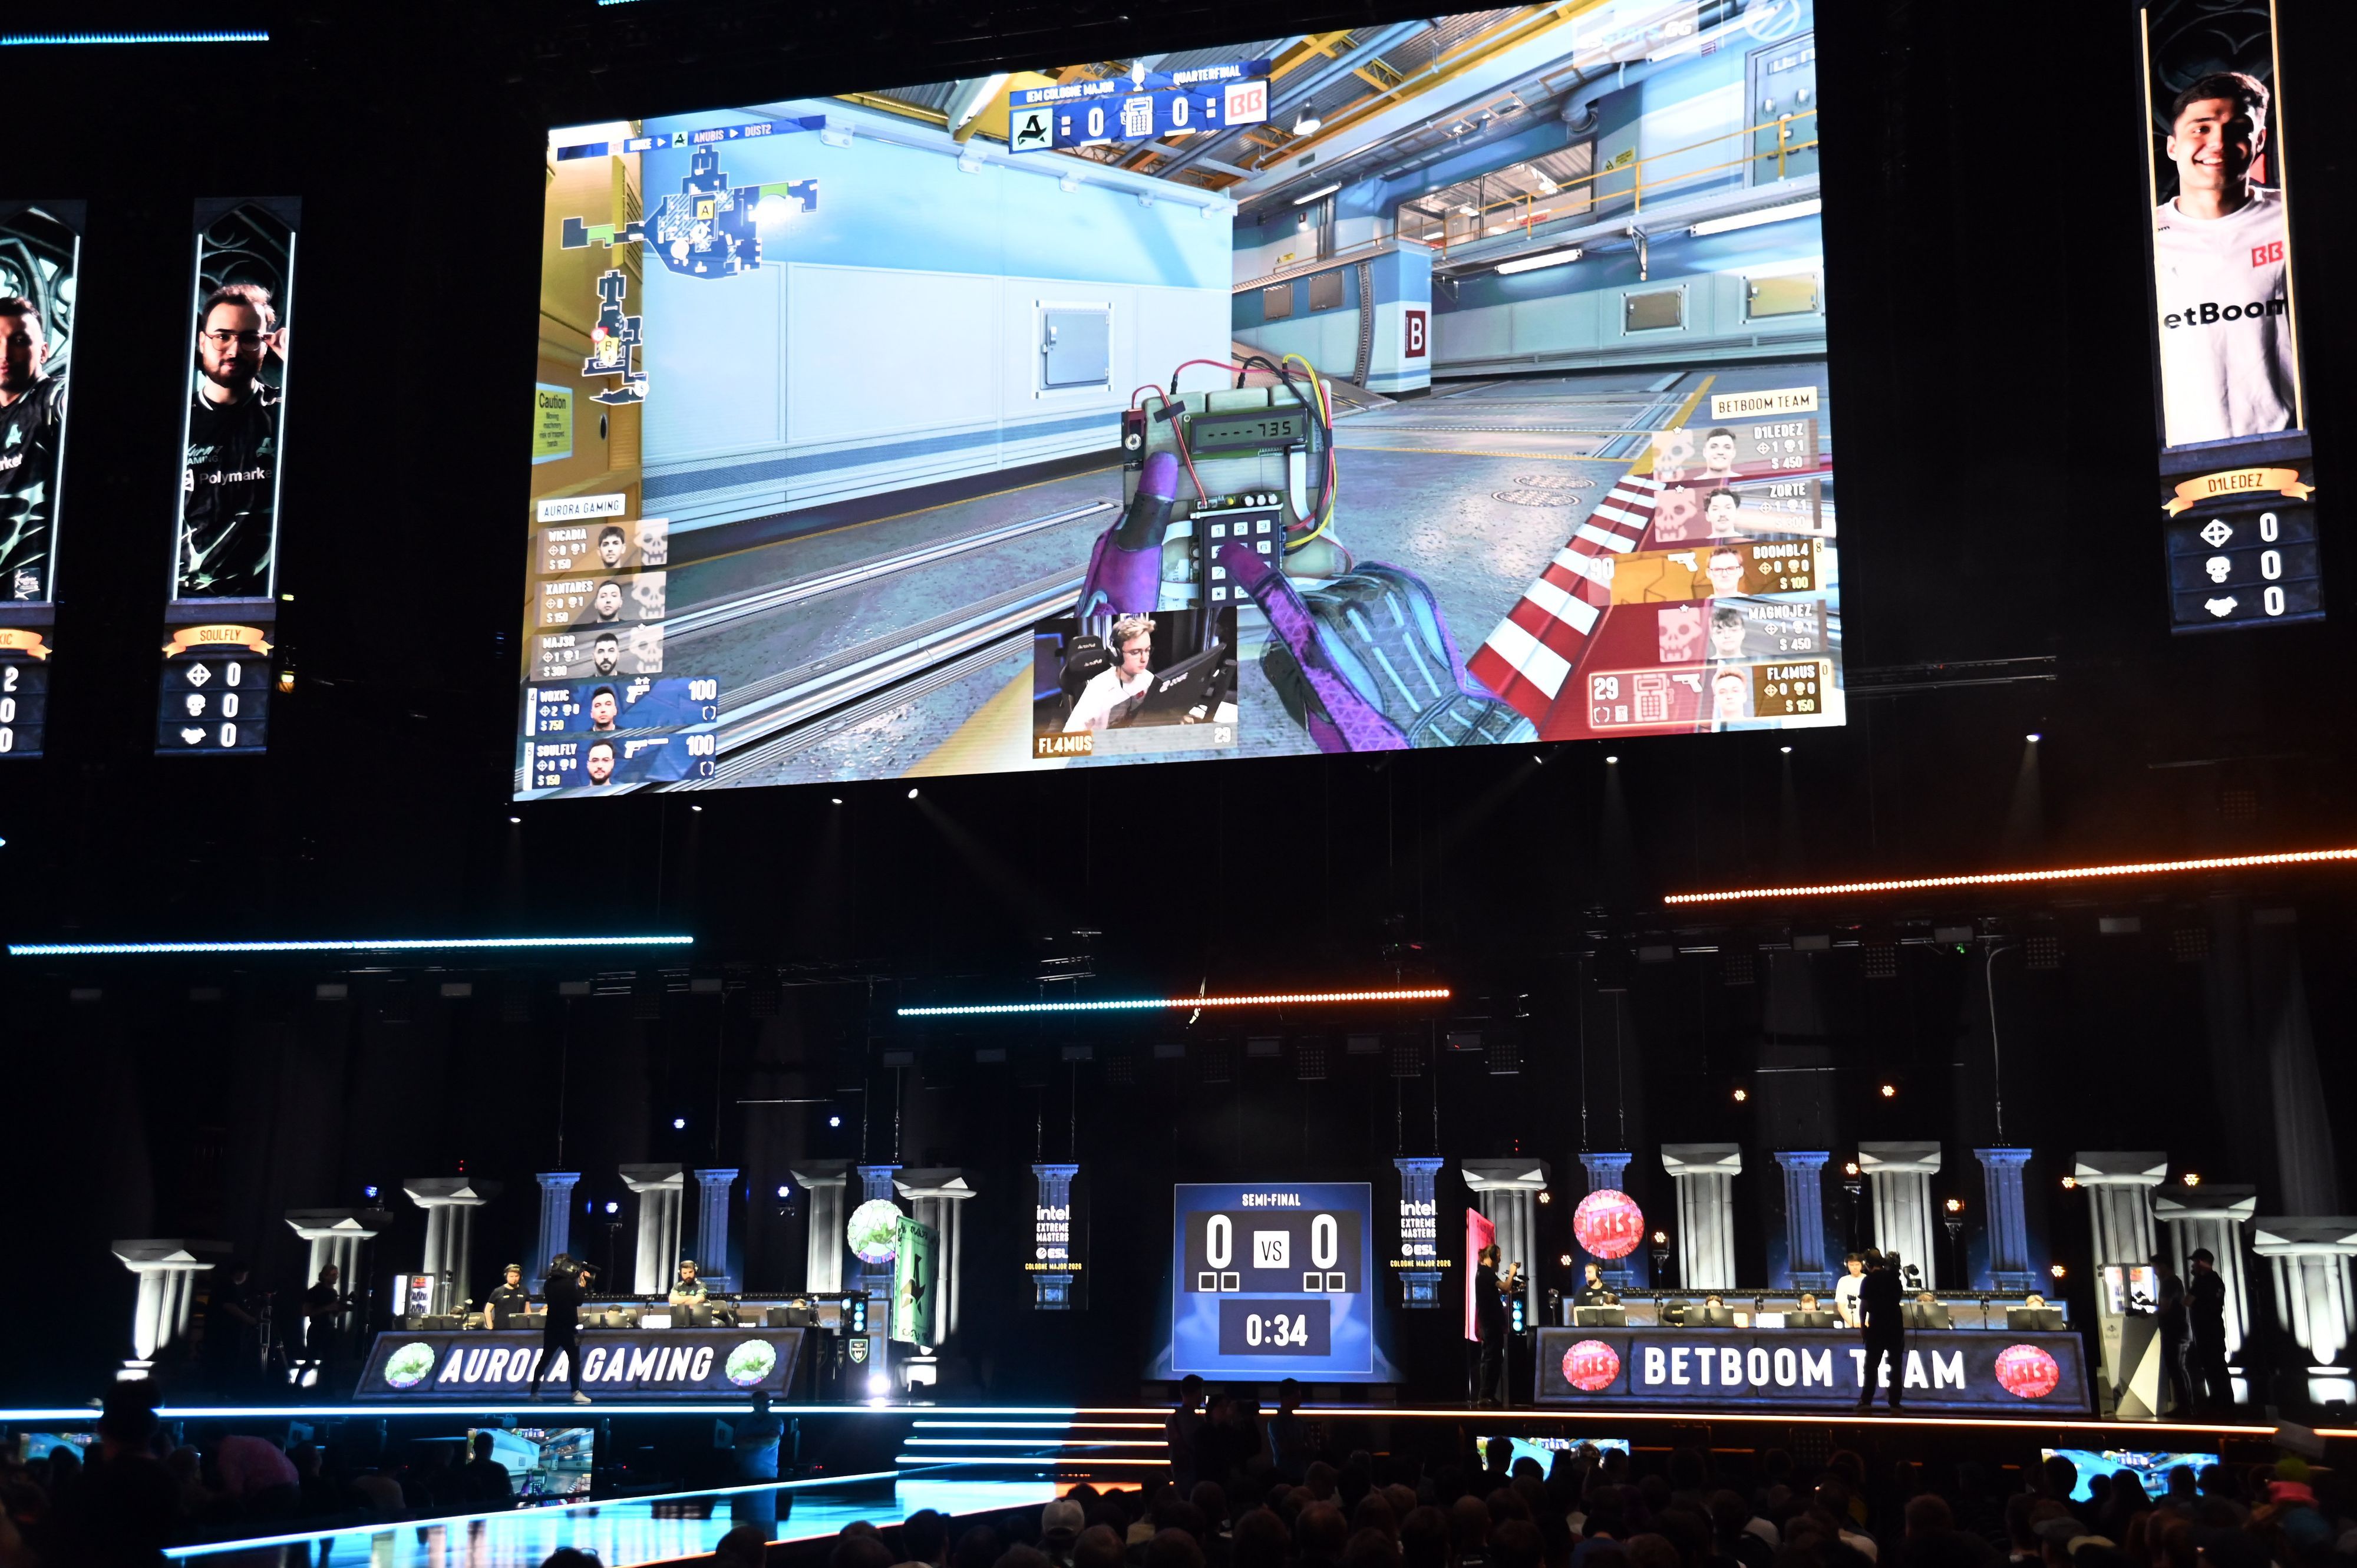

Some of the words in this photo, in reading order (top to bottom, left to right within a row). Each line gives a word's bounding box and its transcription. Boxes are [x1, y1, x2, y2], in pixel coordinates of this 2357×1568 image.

[1173, 65, 1241, 86] QUARTERFINAL
[1026, 90, 1042, 104] IEM
[1043, 85, 1082, 101] COLOGNE
[1083, 81, 1115, 97] MAJOR
[1230, 88, 1263, 118] BB
[1088, 108, 1104, 137] 0
[1172, 97, 1189, 127] 0
[693, 130, 725, 143] ANUBIS
[744, 124, 771, 137] DUST2
[701, 205, 709, 216] A
[2252, 240, 2283, 269] BB
[1411, 318, 1423, 351] B
[605, 341, 612, 351] B
[539, 392, 566, 409] Caution
[1718, 397, 1773, 413] BETBOOM
[1778, 394, 1810, 408] TEAM
[1754, 422, 1804, 440] D1LEDEZ
[1772, 441, 1778, 453] 1
[1797, 440, 1804, 451] 1
[1782, 455, 1803, 469] 450
[1770, 483, 1806, 498] ZORTE
[2208, 473, 2263, 493] D1LEDEZ
[544, 504, 579, 516] AURORA
[583, 500, 619, 513] GAMING
[548, 528, 587, 542] WICADIA
[2259, 512, 2278, 542] 0
[557, 559, 572, 570] 150
[1590, 557, 1615, 580] 90
[1752, 543, 1810, 560] BOOMBL4
[1774, 560, 1782, 573] 0
[1801, 559, 1810, 572] 0
[2260, 550, 2282, 580] 0
[545, 581, 593, 595] XANTARES
[1791, 576, 1809, 589] 100
[2264, 586, 2285, 616] 0
[554, 612, 569, 623] 150
[1748, 603, 1813, 620] MAGNOJEZ
[200, 629, 242, 642] SOULFLY
[542, 635, 576, 649] MAJ3R
[1791, 638, 1811, 651] 450
[4, 667, 19, 692] 2
[227, 662, 241, 686] 0
[1593, 676, 1619, 700] 29
[1767, 665, 1815, 681] FL4MUS
[540, 690, 569, 702] WOXIC
[688, 679, 717, 701] 100
[1779, 683, 1788, 696] 0
[1807, 682, 1815, 694] 0
[1, 698, 16, 722] 0
[223, 693, 239, 718] 0
[1796, 699, 1815, 712] 150
[549, 719, 565, 731] 750
[0, 728, 14, 752] 0
[221, 723, 237, 747] 0
[1038, 735, 1093, 754] FL4MUS
[1214, 727, 1232, 744] 29
[536, 743, 577, 757] SOULFLY
[686, 734, 715, 757] 100
[546, 774, 560, 785] 150
[1242, 1193, 1301, 1207] SEMI-FINAL
[1400, 1199, 1438, 1216] intel
[1036, 1204, 1071, 1221] intel
[1036, 1222, 1069, 1232] EXTREME
[1401, 1218, 1436, 1228] EXTREME
[1036, 1232, 1069, 1242] MASTERS
[1206, 1214, 1233, 1269] 0
[1261, 1240, 1282, 1262] VS
[1311, 1213, 1338, 1269] 0
[1401, 1228, 1437, 1239] MASTERS
[1047, 1247, 1069, 1259] ESL
[1414, 1244, 1437, 1256] ESL
[1390, 1259, 1414, 1267] COLOGNE
[1416, 1259, 1435, 1267] MAJOR
[1246, 1313, 1309, 1347] 0:34
[582, 1347, 714, 1382] GAMING
[1645, 1347, 1833, 1387] BETBOOM
